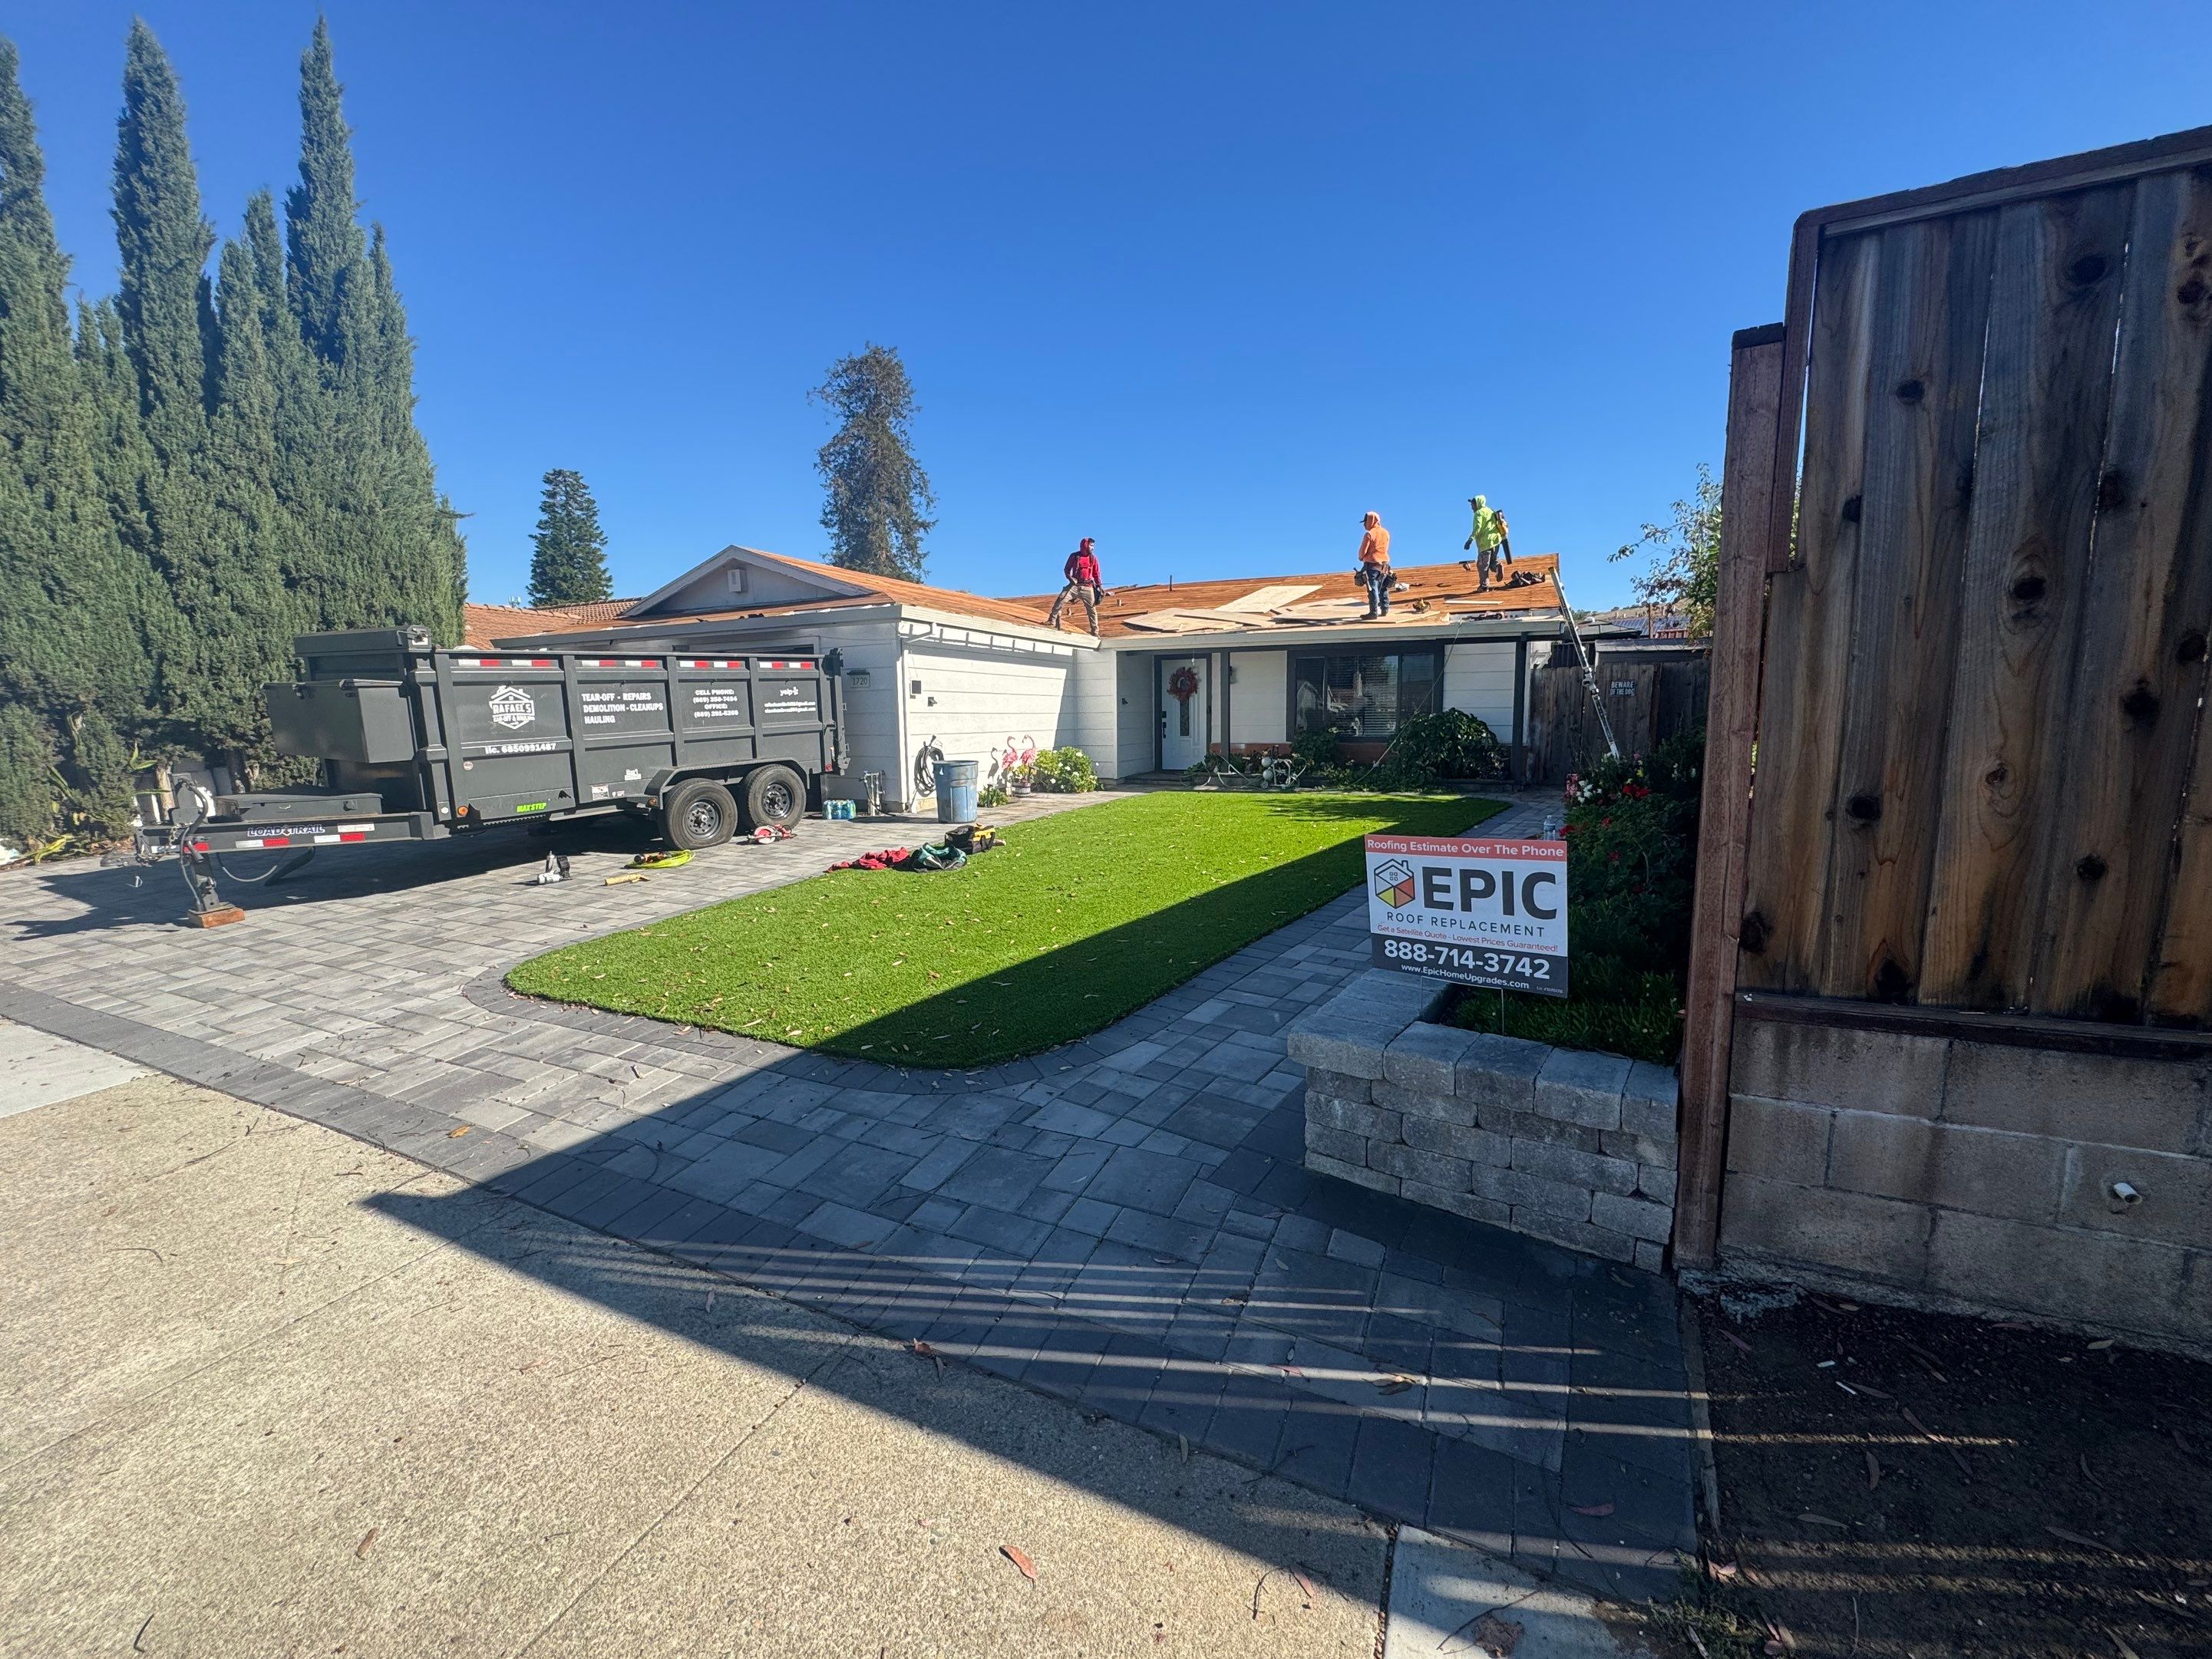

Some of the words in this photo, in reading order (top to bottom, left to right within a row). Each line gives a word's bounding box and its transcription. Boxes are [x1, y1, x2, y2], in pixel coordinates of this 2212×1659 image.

[581, 693, 615, 701] TEAR-OFF
[622, 692, 652, 701] REPAIRS
[493, 703, 532, 714] RAFAEL'S
[583, 704, 626, 713] DEMOLITION
[629, 703, 664, 711] CLEANUPS
[584, 715, 616, 724] HAULING
[247, 826, 282, 836] LOAD
[289, 824, 325, 835] TRAIL
[1367, 839, 1407, 852] Roofing
[1410, 842, 1458, 853] Estimate
[1461, 843, 1491, 854] Over
[1494, 845, 1518, 855] The
[1522, 846, 1564, 856] Phone
[1422, 866, 1557, 920] EPIC
[1387, 912, 1424, 925] ROOF
[1431, 916, 1545, 937] REPLACEMENT
[1396, 927, 1423, 936] Satellite
[1424, 931, 1447, 939] Quote
[1453, 934, 1481, 944] Lowest
[1481, 937, 1505, 946] Prices
[1507, 940, 1558, 952] Guaranteed!
[1384, 939, 1550, 979] 888-714-3742
[1401, 964, 1530, 989] www.EpicHomeUpgrades.com
